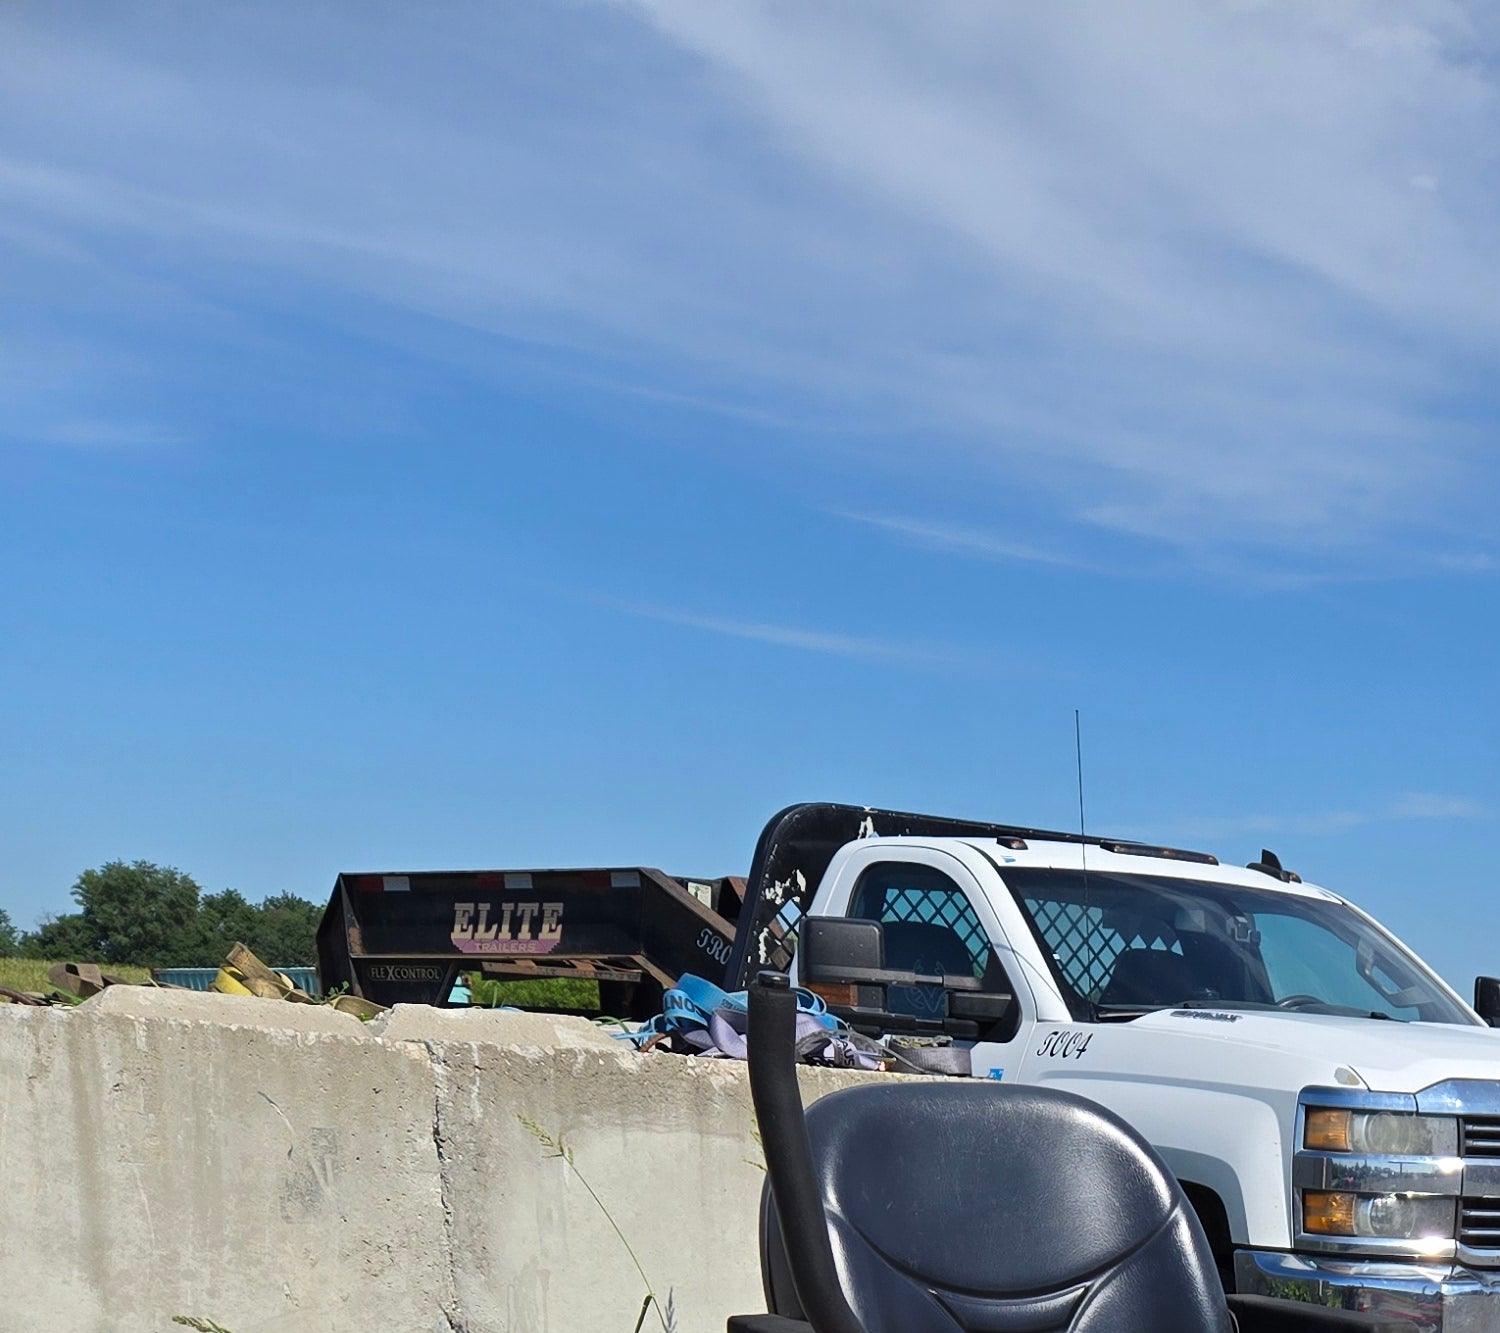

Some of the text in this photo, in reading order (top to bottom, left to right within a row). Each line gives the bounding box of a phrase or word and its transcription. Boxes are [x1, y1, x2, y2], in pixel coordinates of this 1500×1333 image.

[451, 902, 564, 940] ELITE
[474, 942, 536, 952] TRAILERS
[371, 965, 440, 981] FLEXCONTROL
